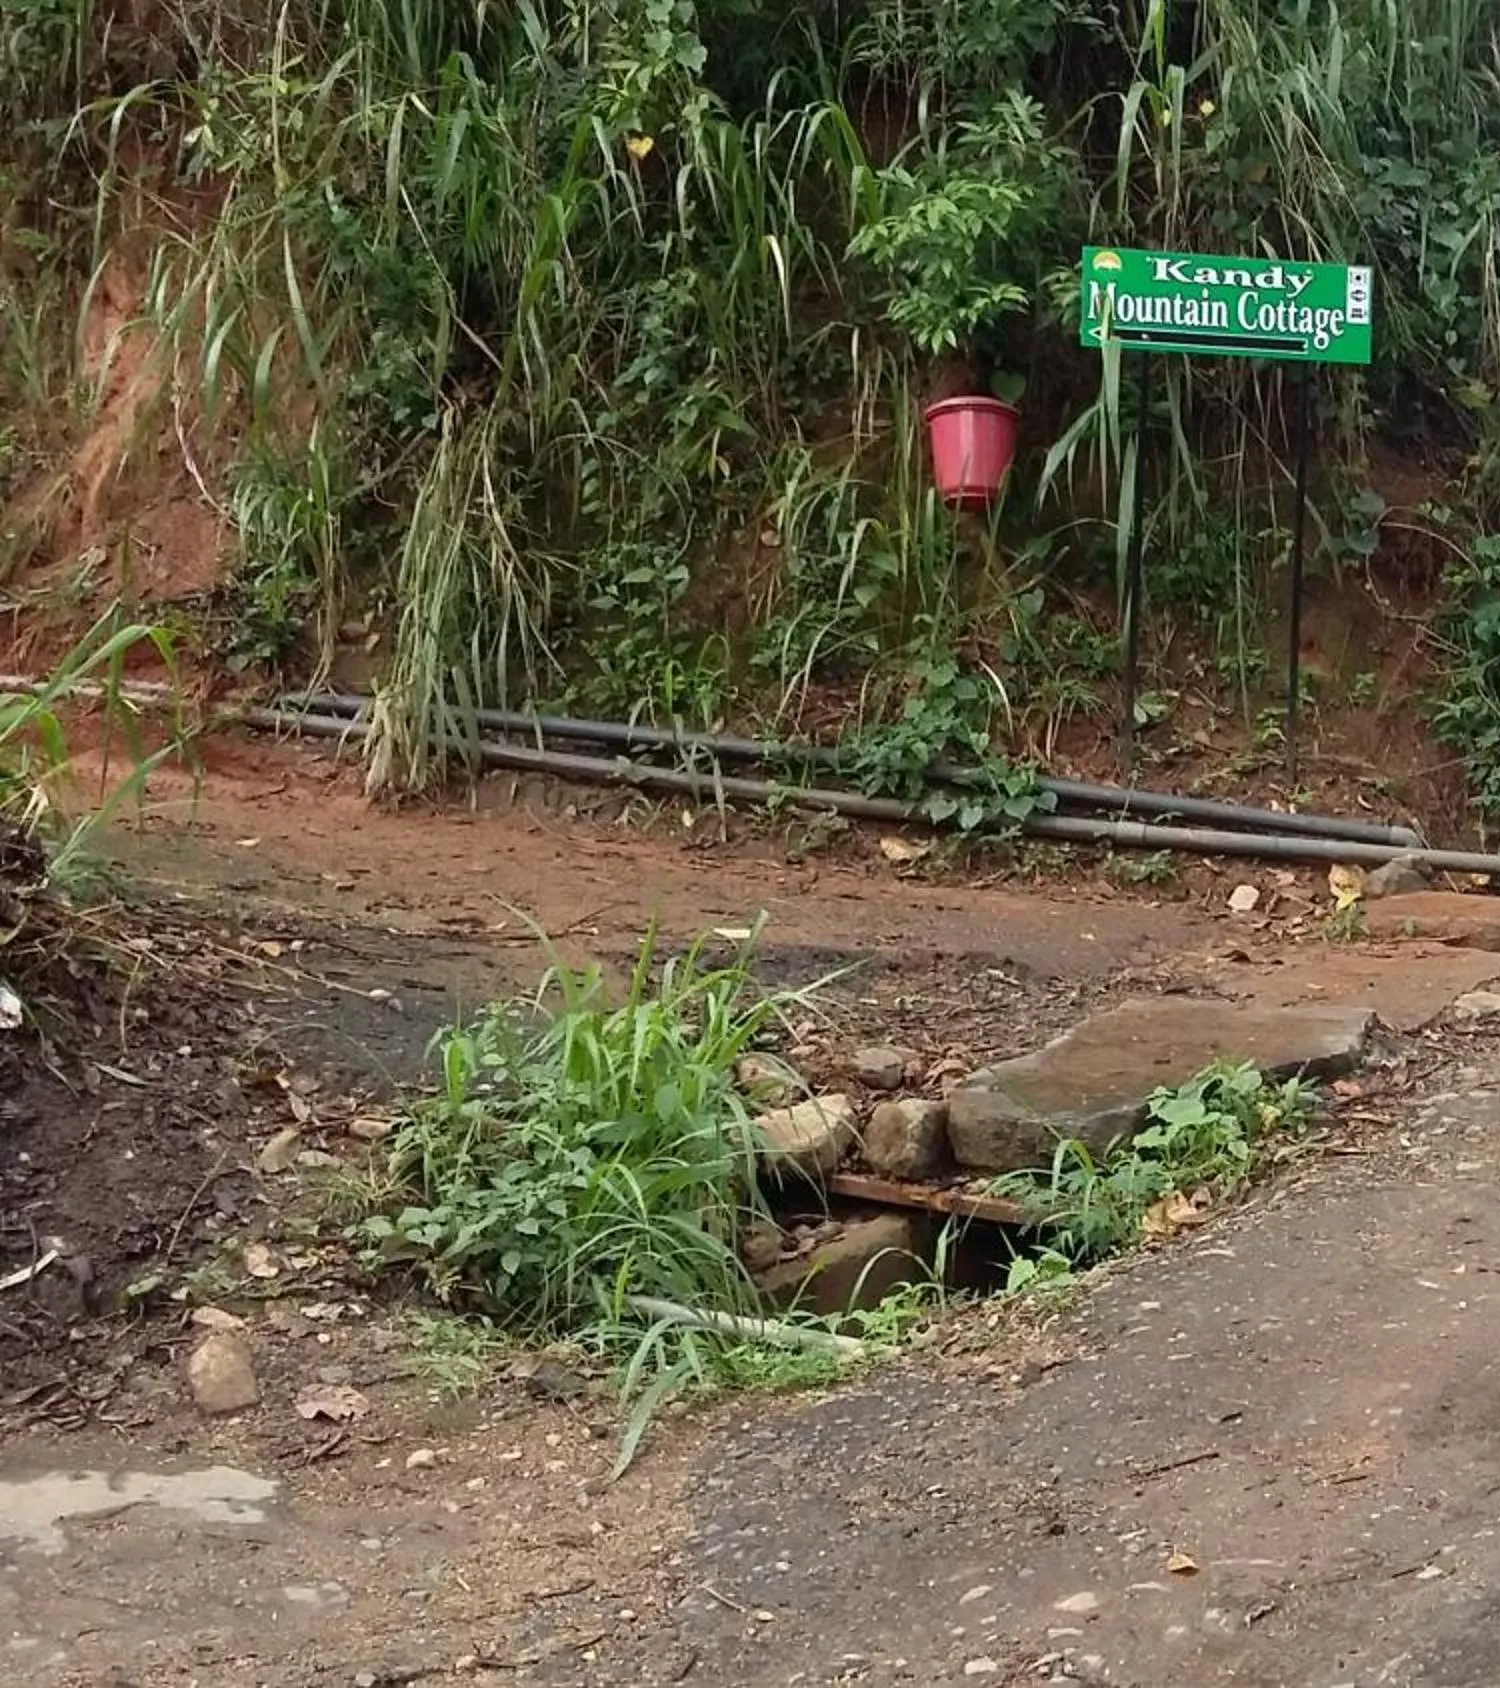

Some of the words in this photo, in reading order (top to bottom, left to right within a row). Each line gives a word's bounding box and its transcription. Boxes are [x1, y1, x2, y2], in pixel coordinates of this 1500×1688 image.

[1146, 256, 1315, 297] Kandy
[1087, 280, 1228, 328] Mountain
[1237, 291, 1345, 350] Cottage
